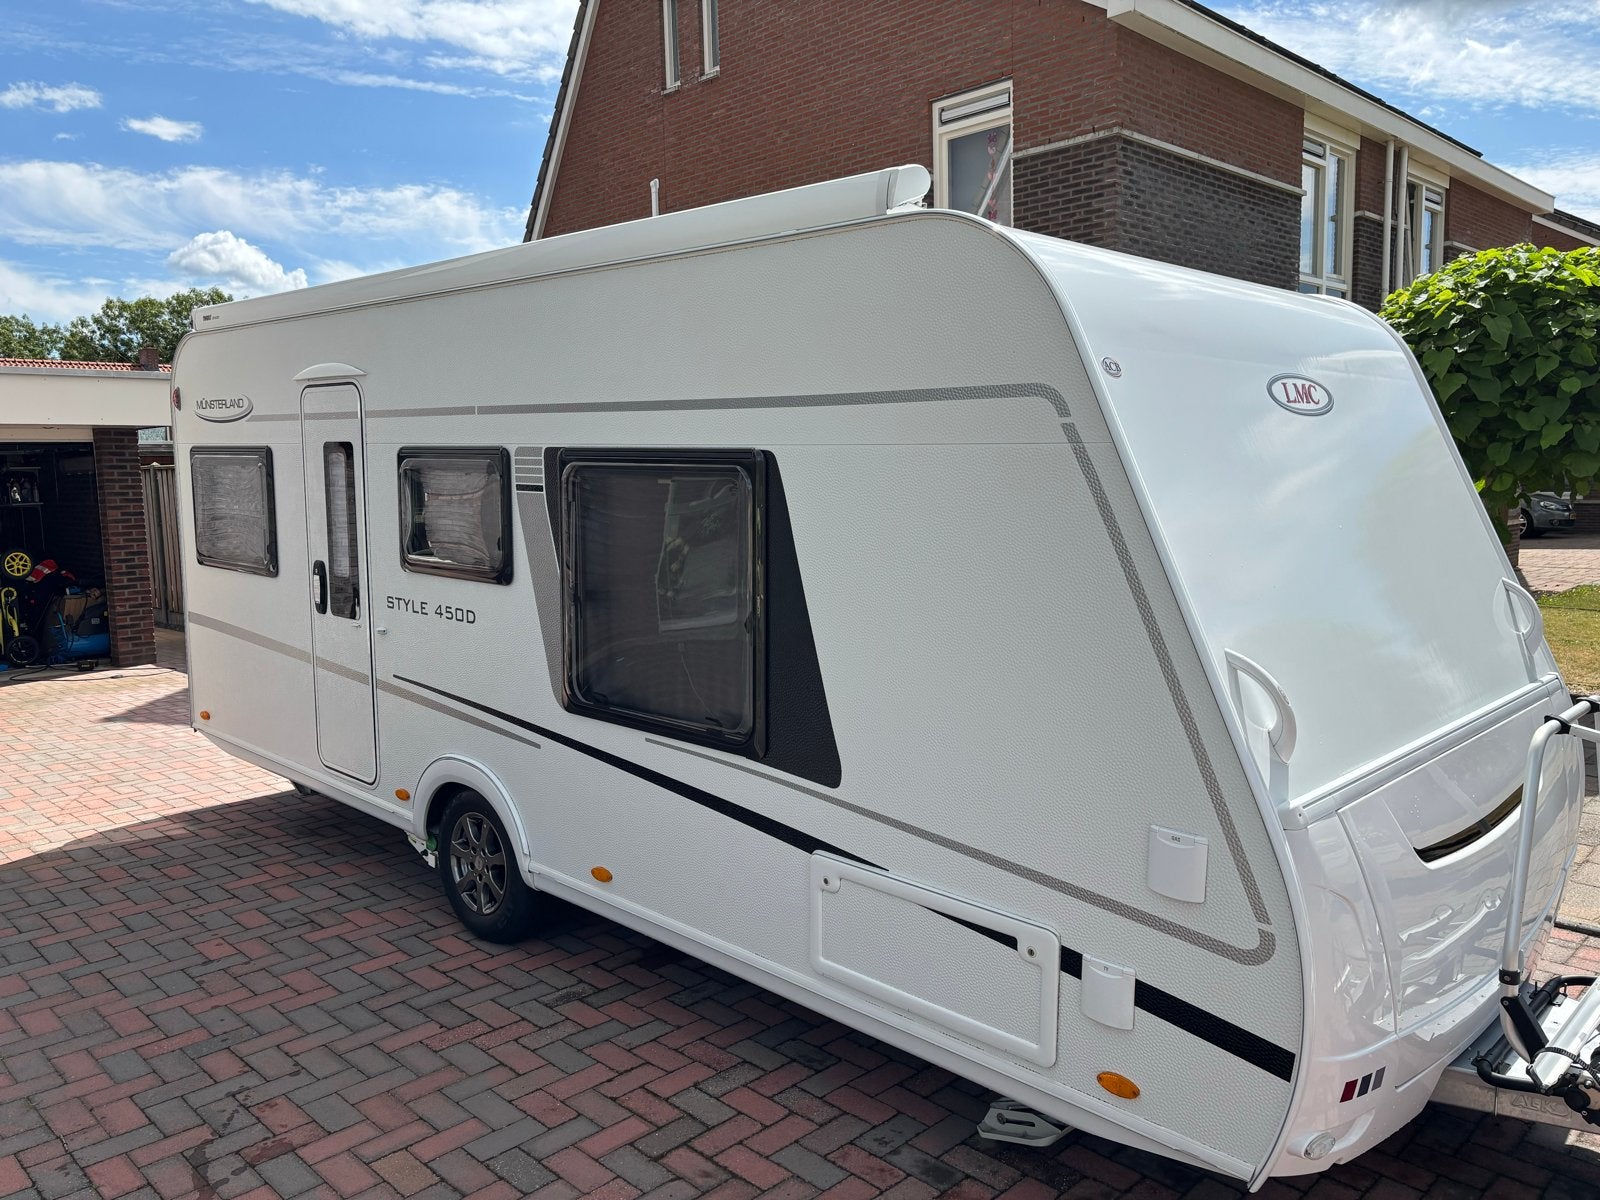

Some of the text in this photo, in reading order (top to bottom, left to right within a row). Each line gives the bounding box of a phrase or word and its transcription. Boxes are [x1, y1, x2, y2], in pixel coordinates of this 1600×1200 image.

[196, 397, 244, 410] MÜNSTERLAND
[1280, 382, 1320, 405] LMC
[386, 595, 476, 624] STYLE 450D
